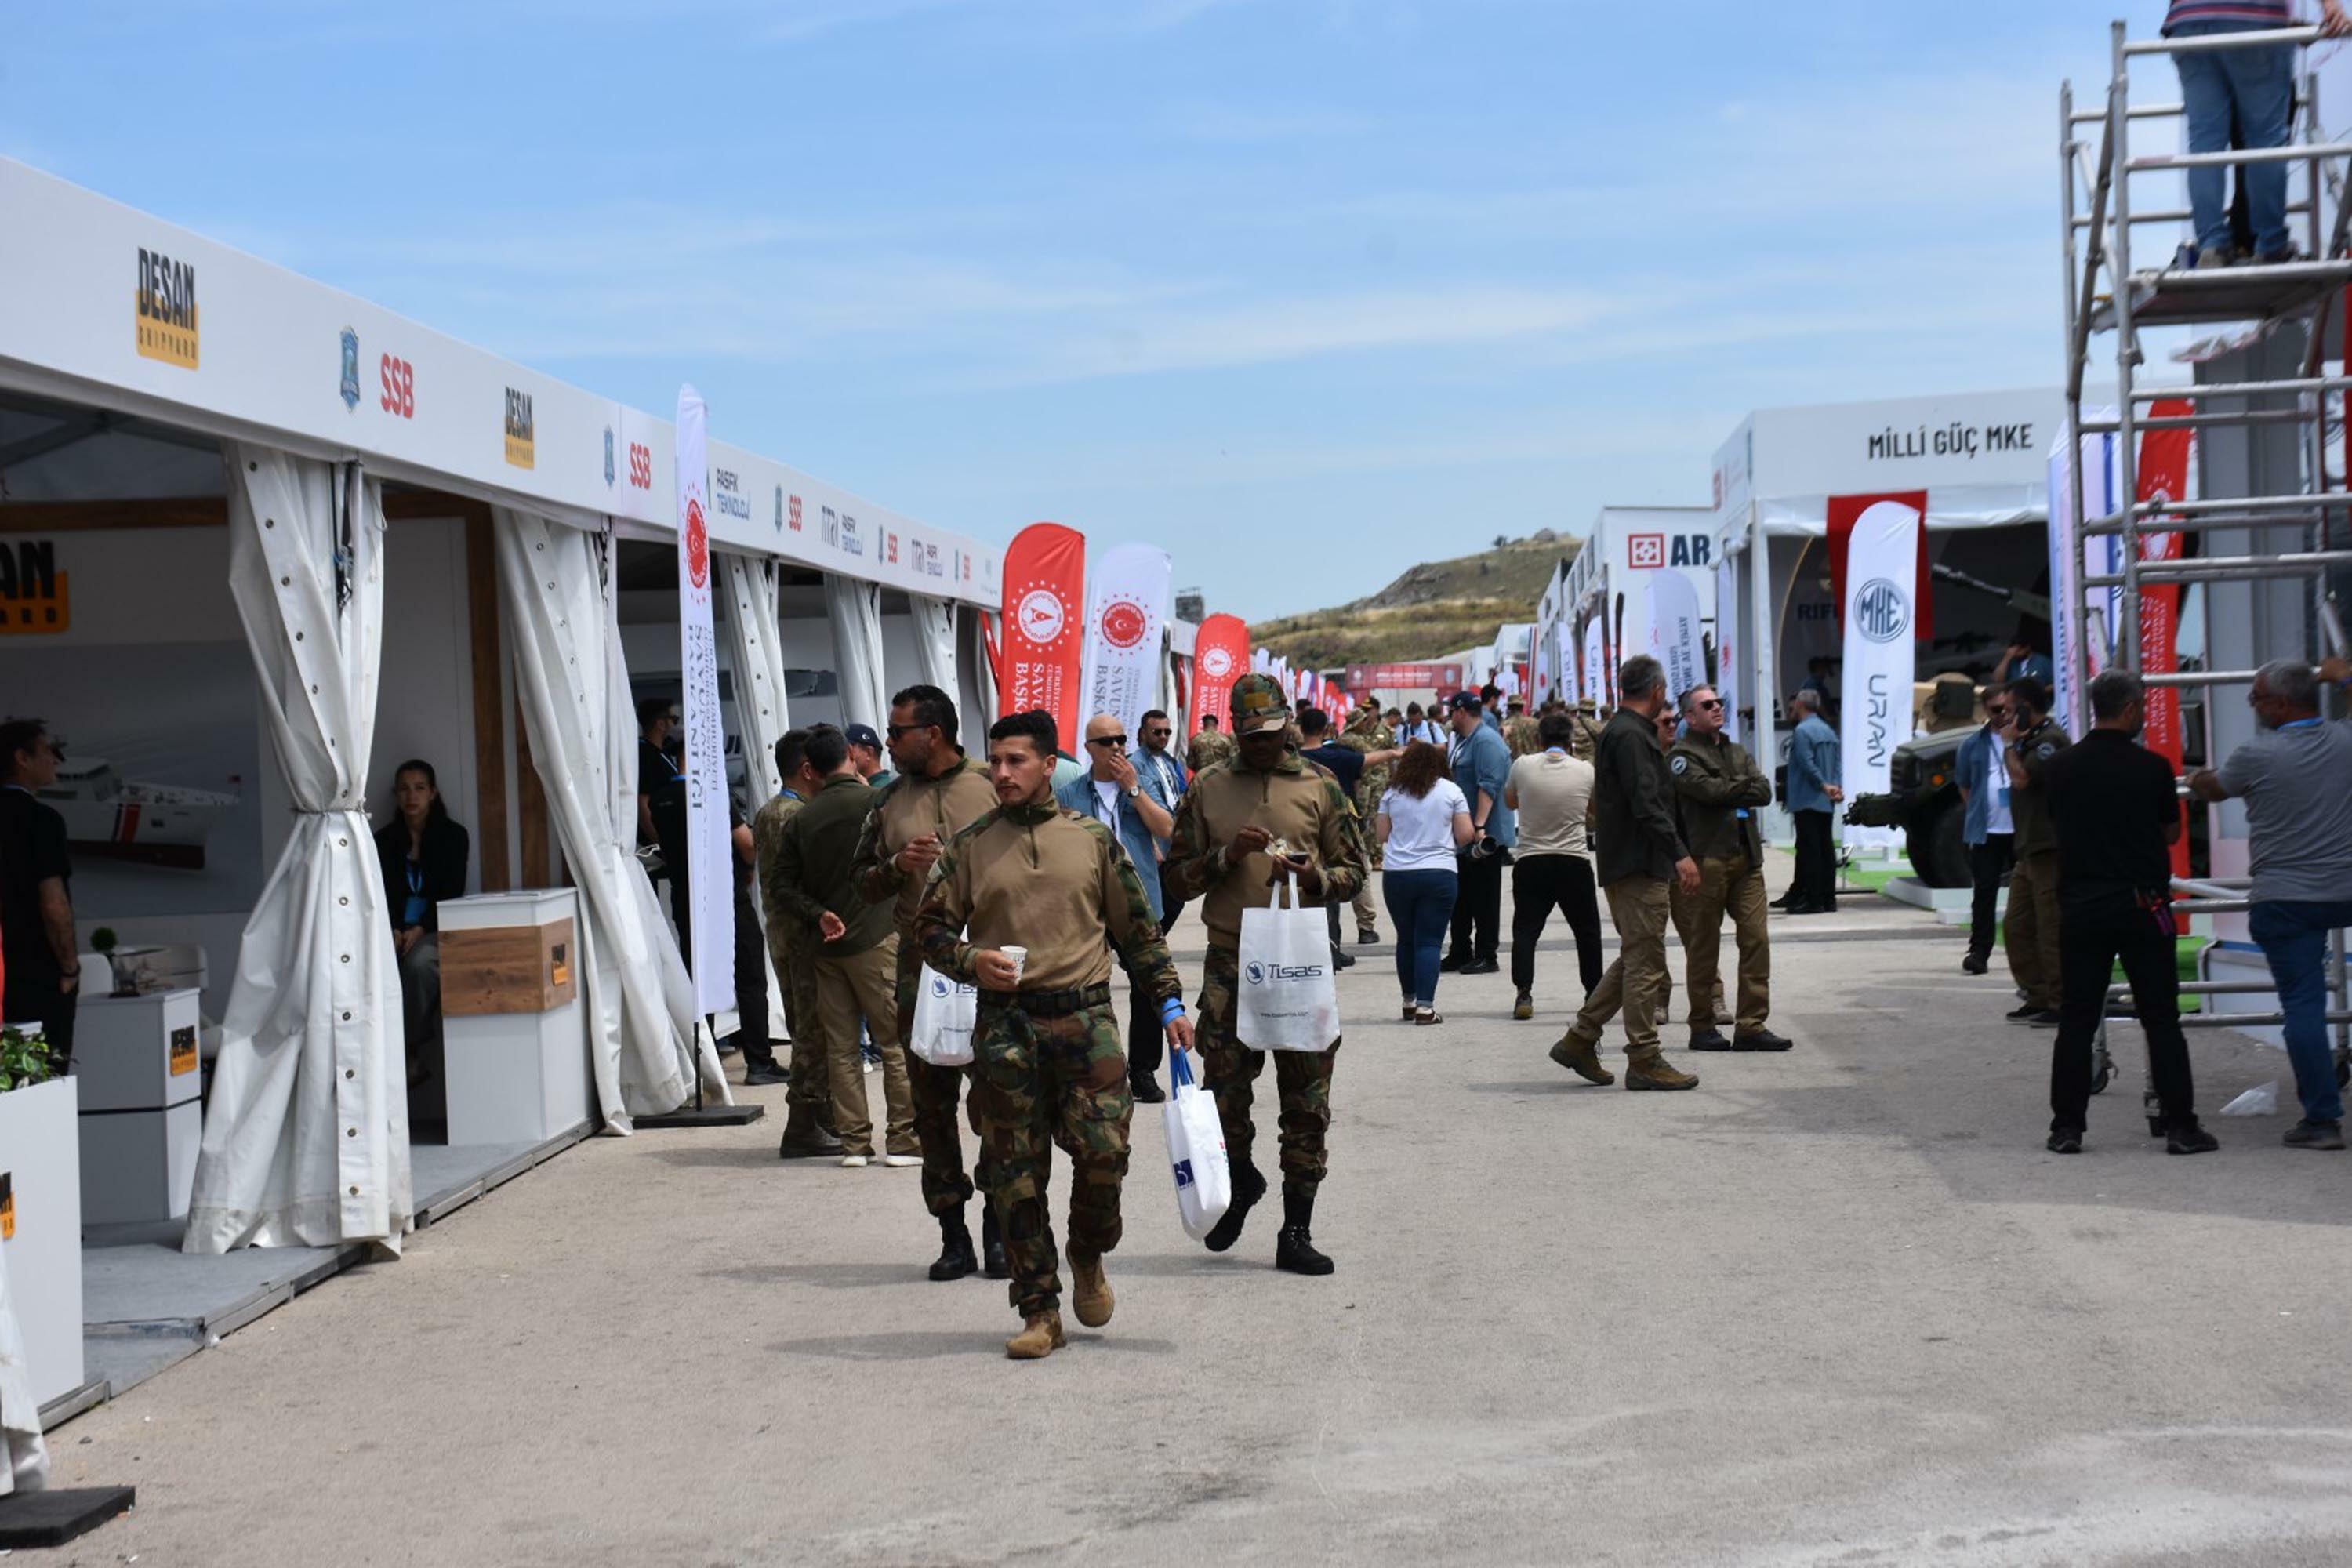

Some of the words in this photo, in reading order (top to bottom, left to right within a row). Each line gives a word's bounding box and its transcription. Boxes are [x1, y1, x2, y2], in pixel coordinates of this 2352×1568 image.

[138, 246, 195, 332] DESAN
[381, 353, 414, 419] SSB
[505, 386, 532, 442] DESAN
[1868, 426, 1926, 459] MİLLİ
[1934, 421, 1978, 459] GÜÇ
[1986, 423, 2033, 452] MKE
[630, 441, 651, 490] SSB
[1860, 586, 1901, 635] MKE
[1031, 662, 1044, 710] SAVU
[1093, 664, 1108, 716] BAŞKA
[1109, 665, 1123, 720] SAVUN
[1867, 674, 1887, 768] URAN
[1268, 964, 1323, 979] Tisas
